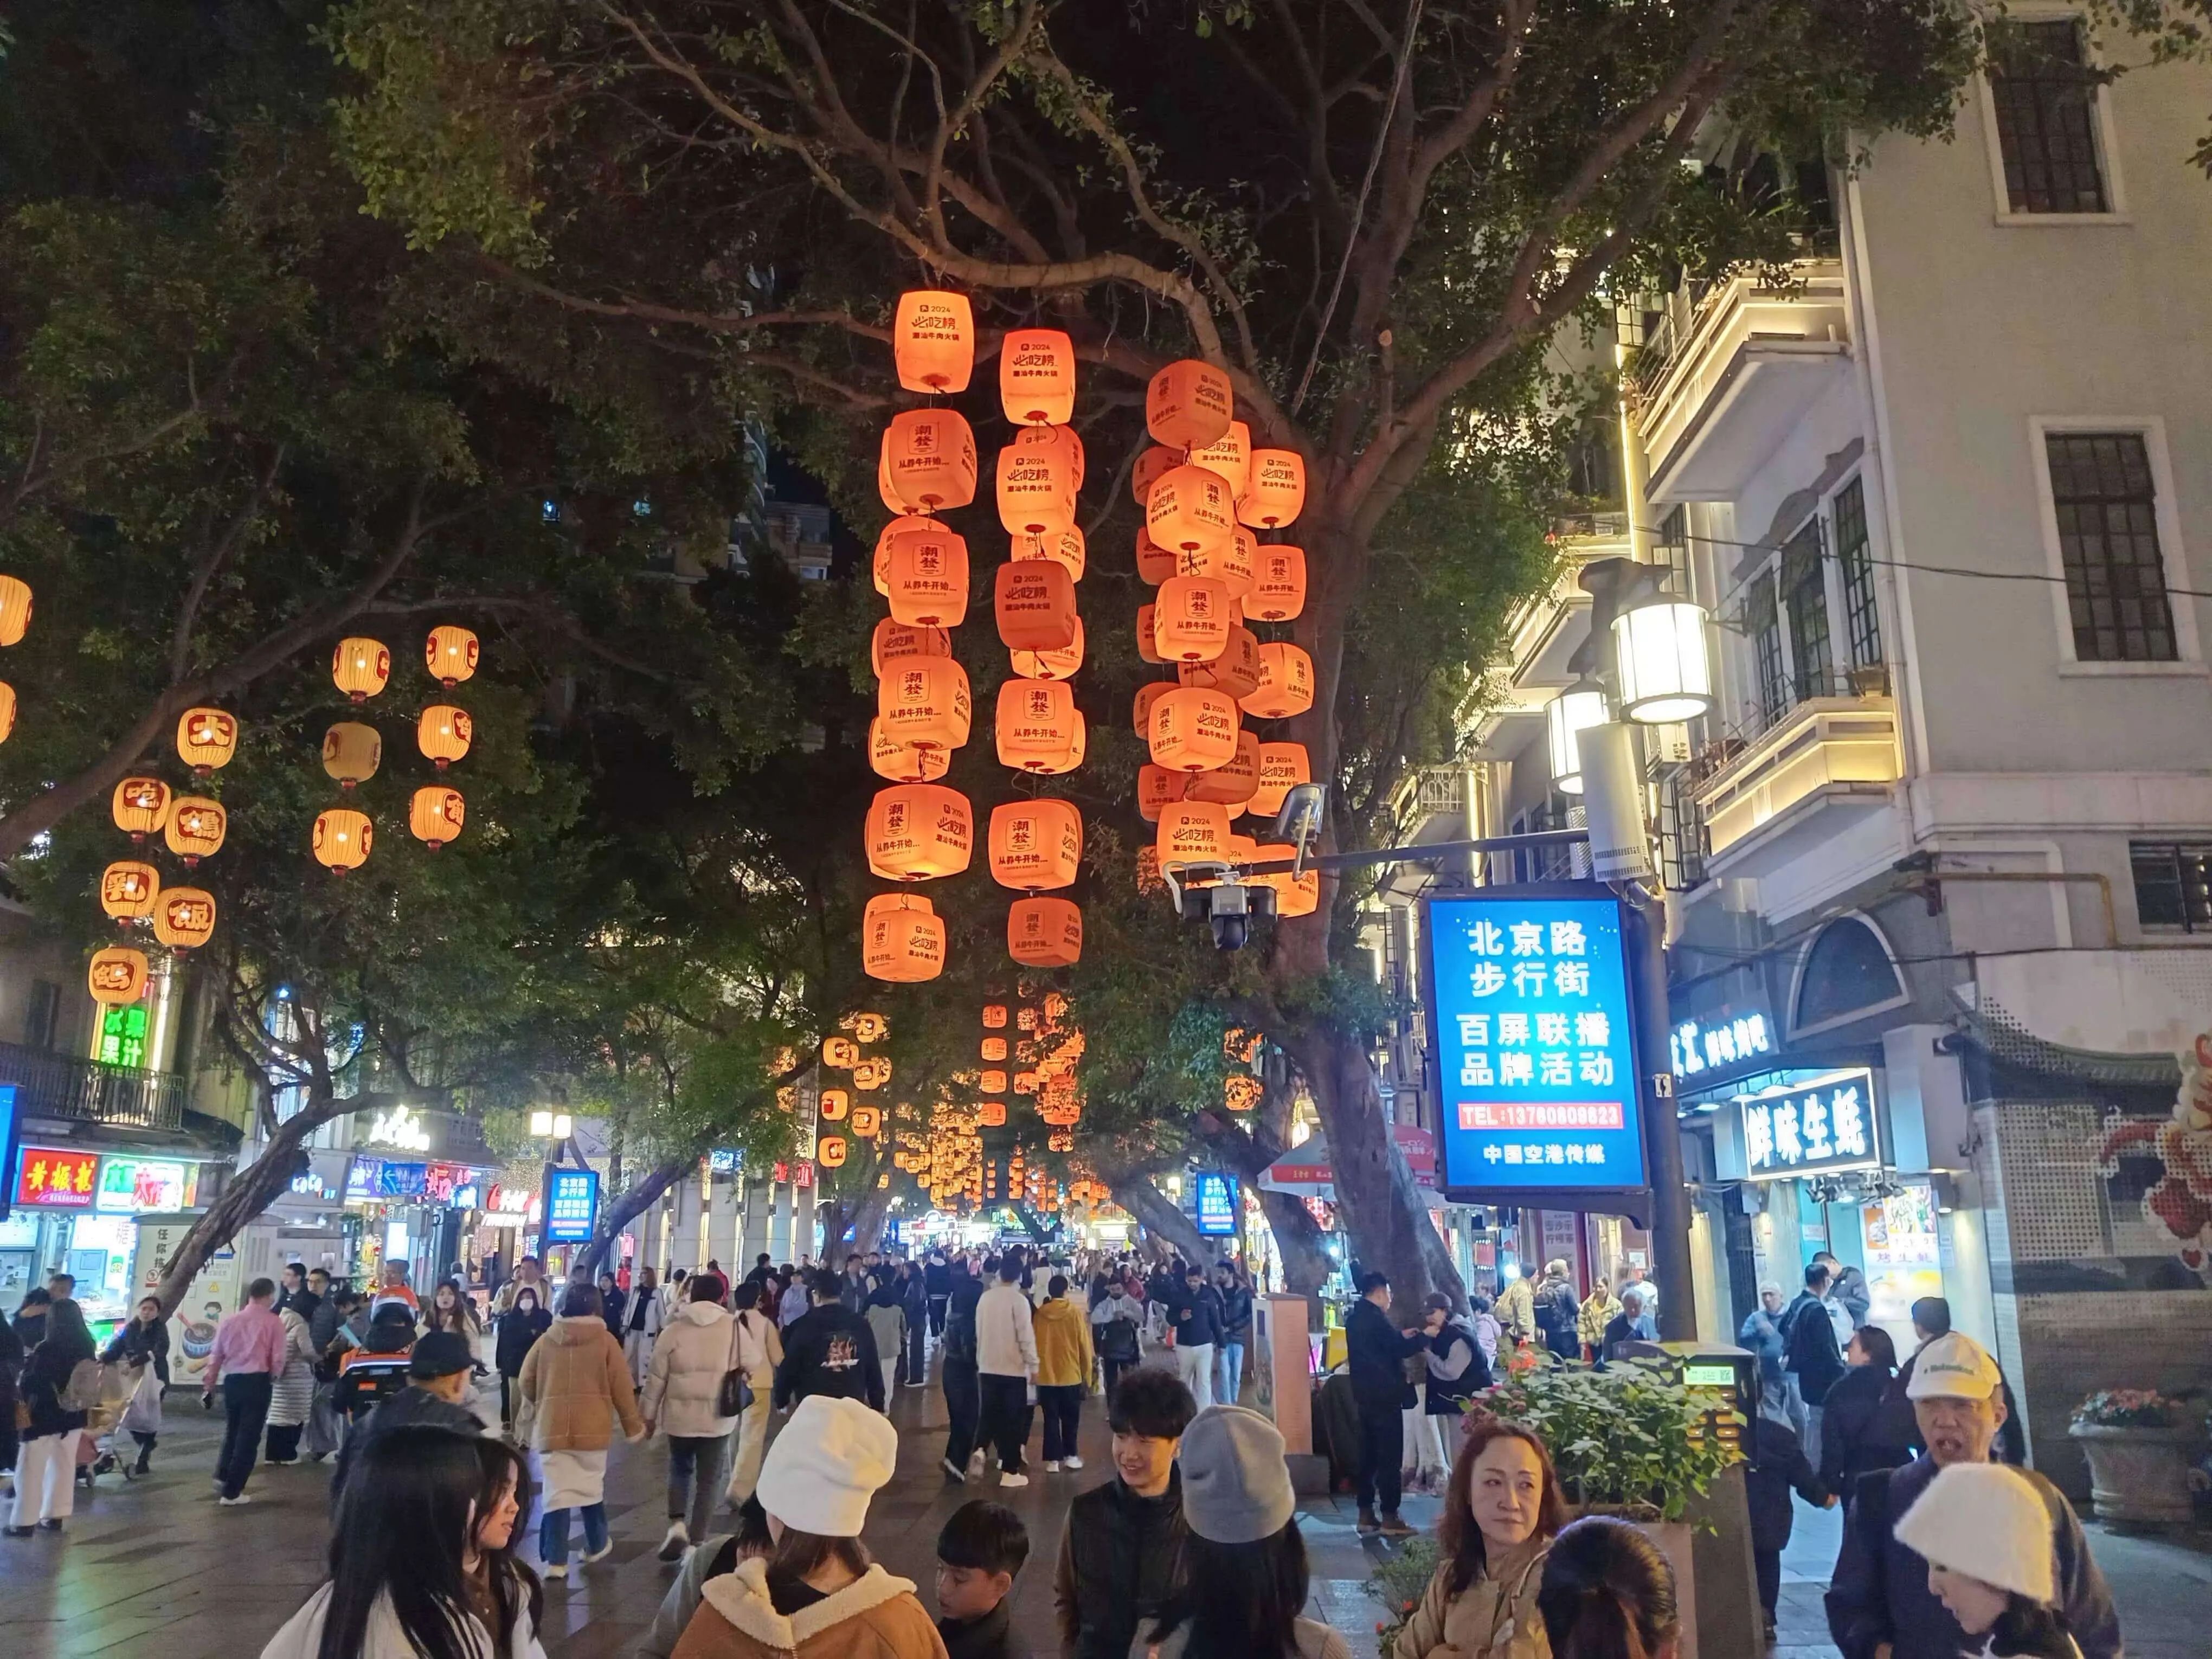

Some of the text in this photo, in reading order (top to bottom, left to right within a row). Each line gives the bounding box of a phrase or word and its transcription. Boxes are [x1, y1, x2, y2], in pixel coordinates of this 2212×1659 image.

[911, 316, 956, 329] 必吃榜
[912, 332, 960, 341] 潮汕牛肉火锅
[1012, 354, 1054, 366] 必吃榜
[1007, 469, 1050, 481] 必吃榜
[1261, 468, 1295, 481] 必吃榜
[1150, 491, 1177, 514] 必吃榜
[920, 546, 940, 569] 潮發
[1005, 587, 1047, 600] 必吃榜
[904, 672, 923, 696] 潮發
[1030, 690, 1049, 713] 潮發
[1212, 704, 1226, 713] 2024
[190, 715, 230, 745] 大
[1197, 712, 1230, 731] 必吃榜
[1260, 766, 1296, 778] 必吃榜
[888, 803, 904, 828] 潮發
[936, 816, 967, 839] 必吃榜
[1012, 820, 1031, 844] 潮發
[1172, 828, 1215, 842] 必吃榜
[1173, 845, 1217, 853] 潮汕牛肉火锅
[106, 872, 146, 901] 乳
[923, 927, 936, 936] 2024
[1467, 920, 1587, 956] 北京路
[909, 936, 938, 951] 必吃榜
[1470, 961, 1590, 998] 步行街
[1456, 1012, 1611, 1047] 百屏联播
[1460, 1051, 1614, 1086] 品牌活动
[1747, 1085, 1866, 1168] 鲜味生蚝
[1483, 1143, 1606, 1165] 中国空港传媒
